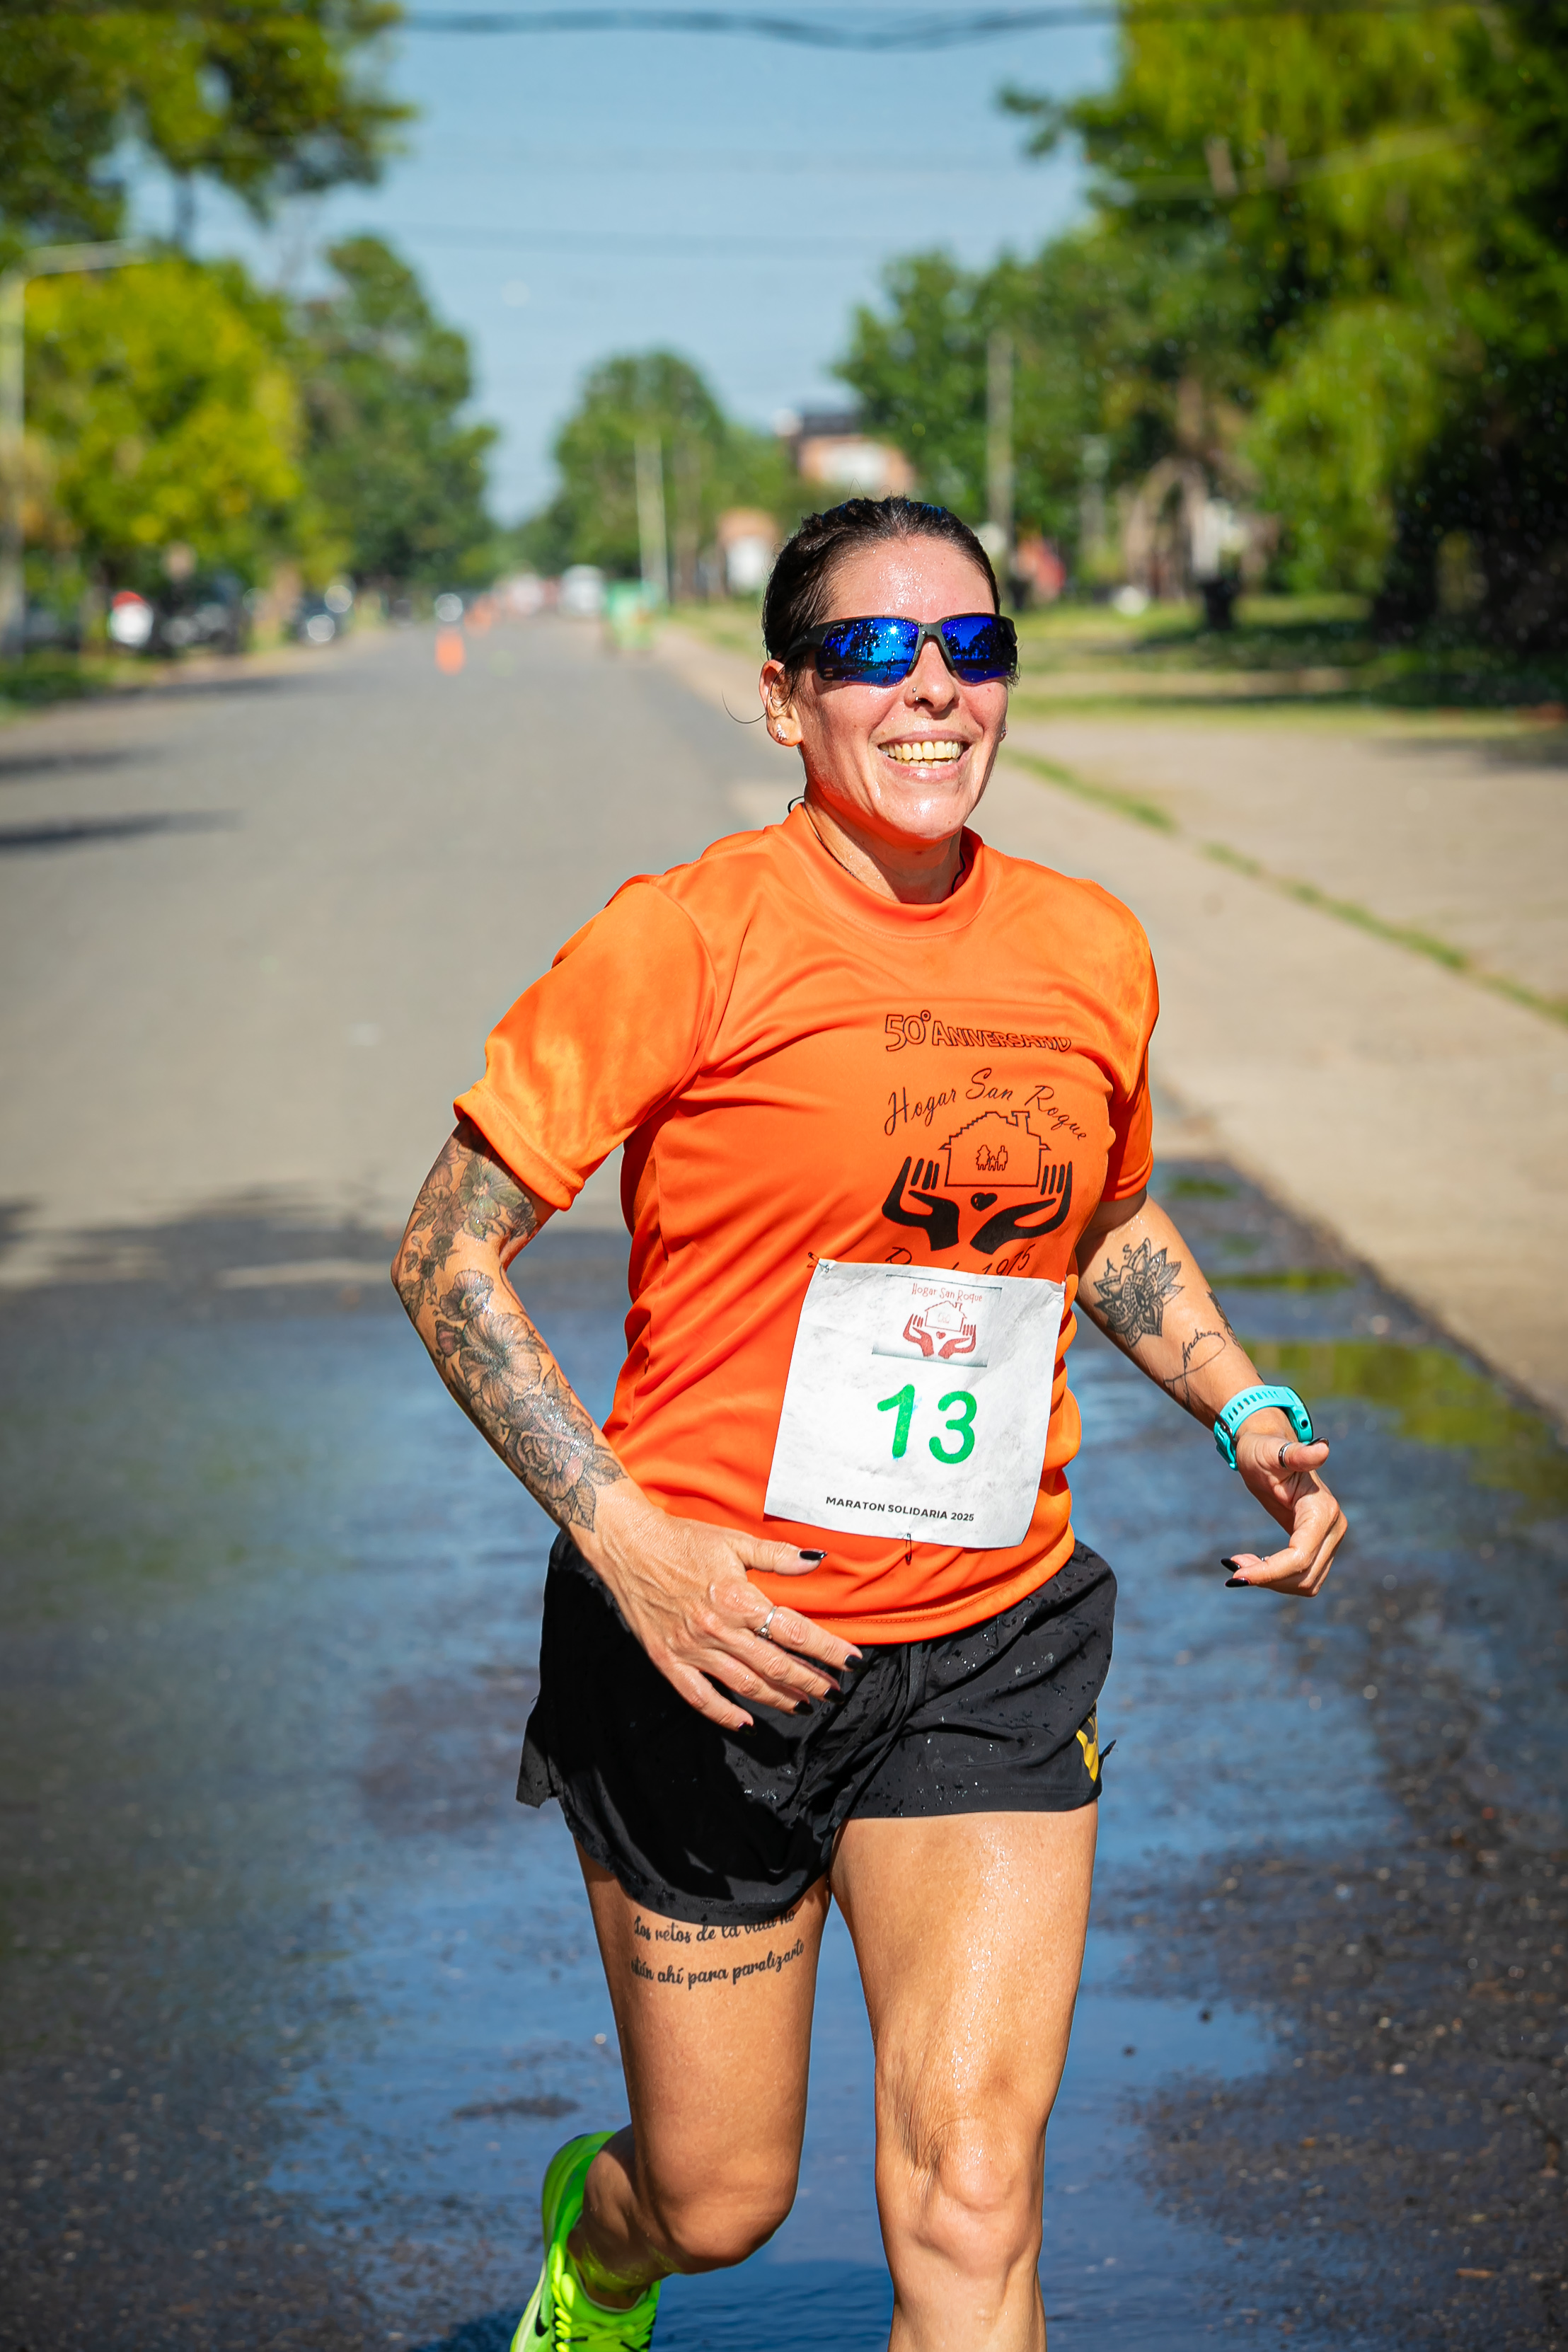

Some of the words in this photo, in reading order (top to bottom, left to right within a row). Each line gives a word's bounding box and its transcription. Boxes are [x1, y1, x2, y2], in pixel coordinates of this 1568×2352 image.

[884, 1086, 956, 1136] Hogar
[965, 1068, 1013, 1101] San
[1025, 1085, 1087, 1141] Roque
[911, 1283, 936, 1297] Hogar
[940, 1287, 955, 1299] San
[957, 1290, 983, 1302] Roque
[877, 1383, 977, 1465] 13
[826, 1497, 885, 1512] MARATON
[888, 1504, 948, 1519] SOLIDARIA
[950, 1512, 974, 1521] 2025
[655, 1922, 692, 1943] retos
[696, 1925, 717, 1942] de
[722, 1925, 741, 1937] la
[657, 1964, 684, 1984] ahí
[688, 1968, 729, 1990] para
[732, 1938, 805, 1985] paralizarte
